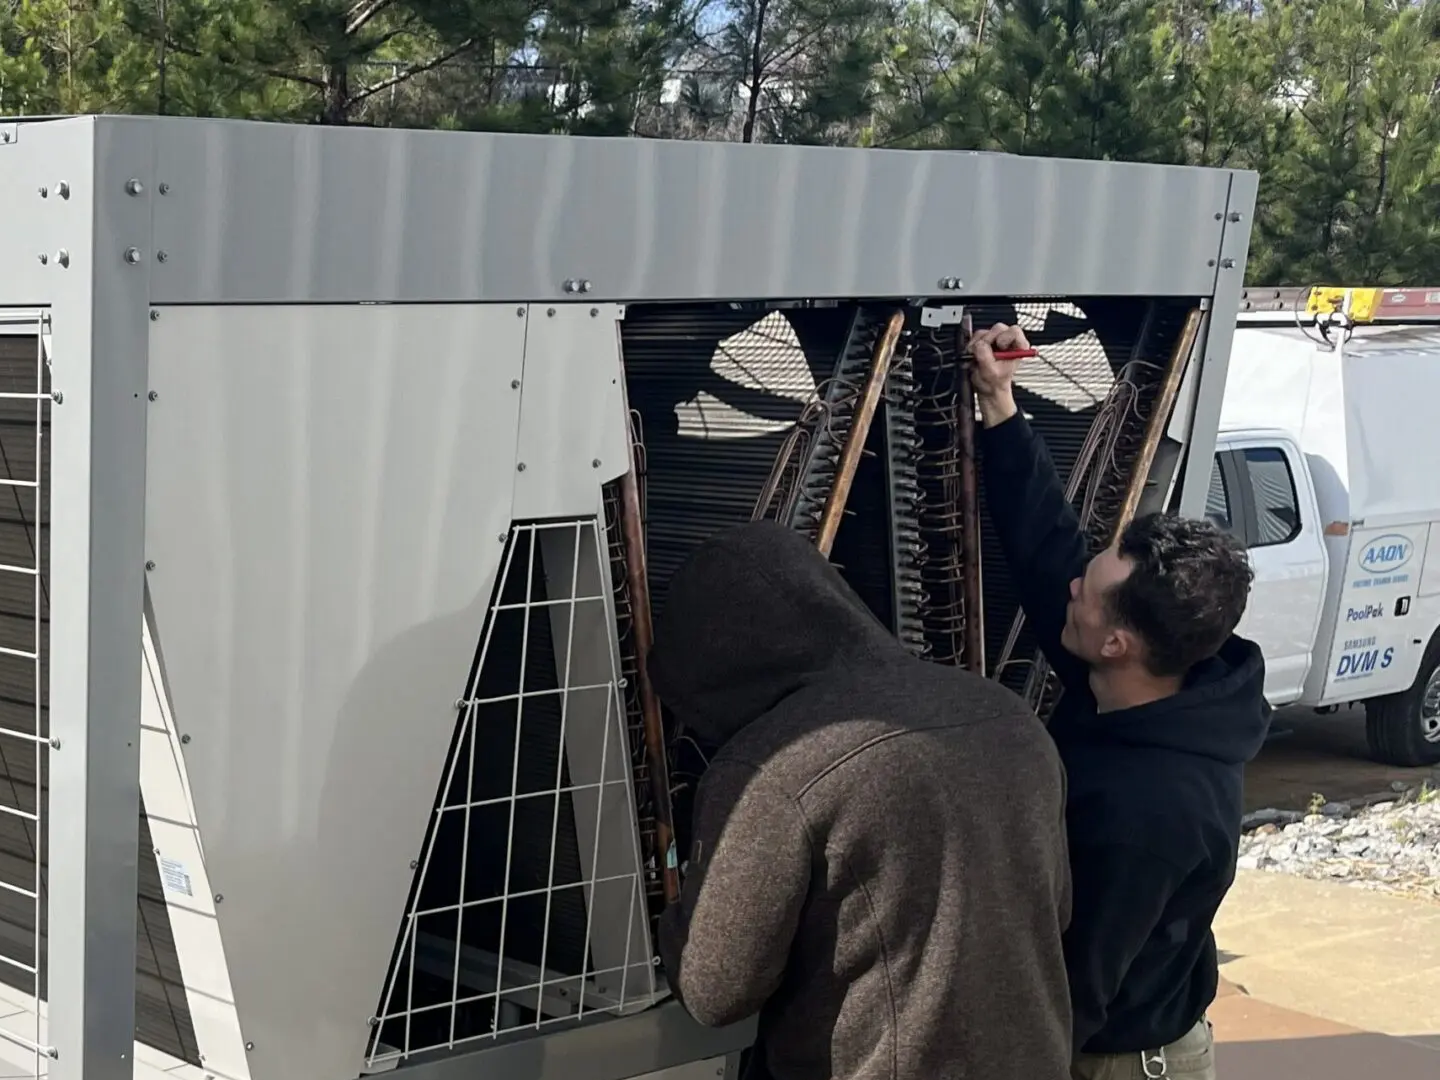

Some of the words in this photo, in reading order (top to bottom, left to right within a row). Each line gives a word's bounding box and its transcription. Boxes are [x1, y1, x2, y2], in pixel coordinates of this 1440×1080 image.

[1362, 544, 1408, 565] AAON
[1346, 602, 1384, 622] PoolPak
[1336, 649, 1379, 676] DVM
[1381, 647, 1394, 669] S
